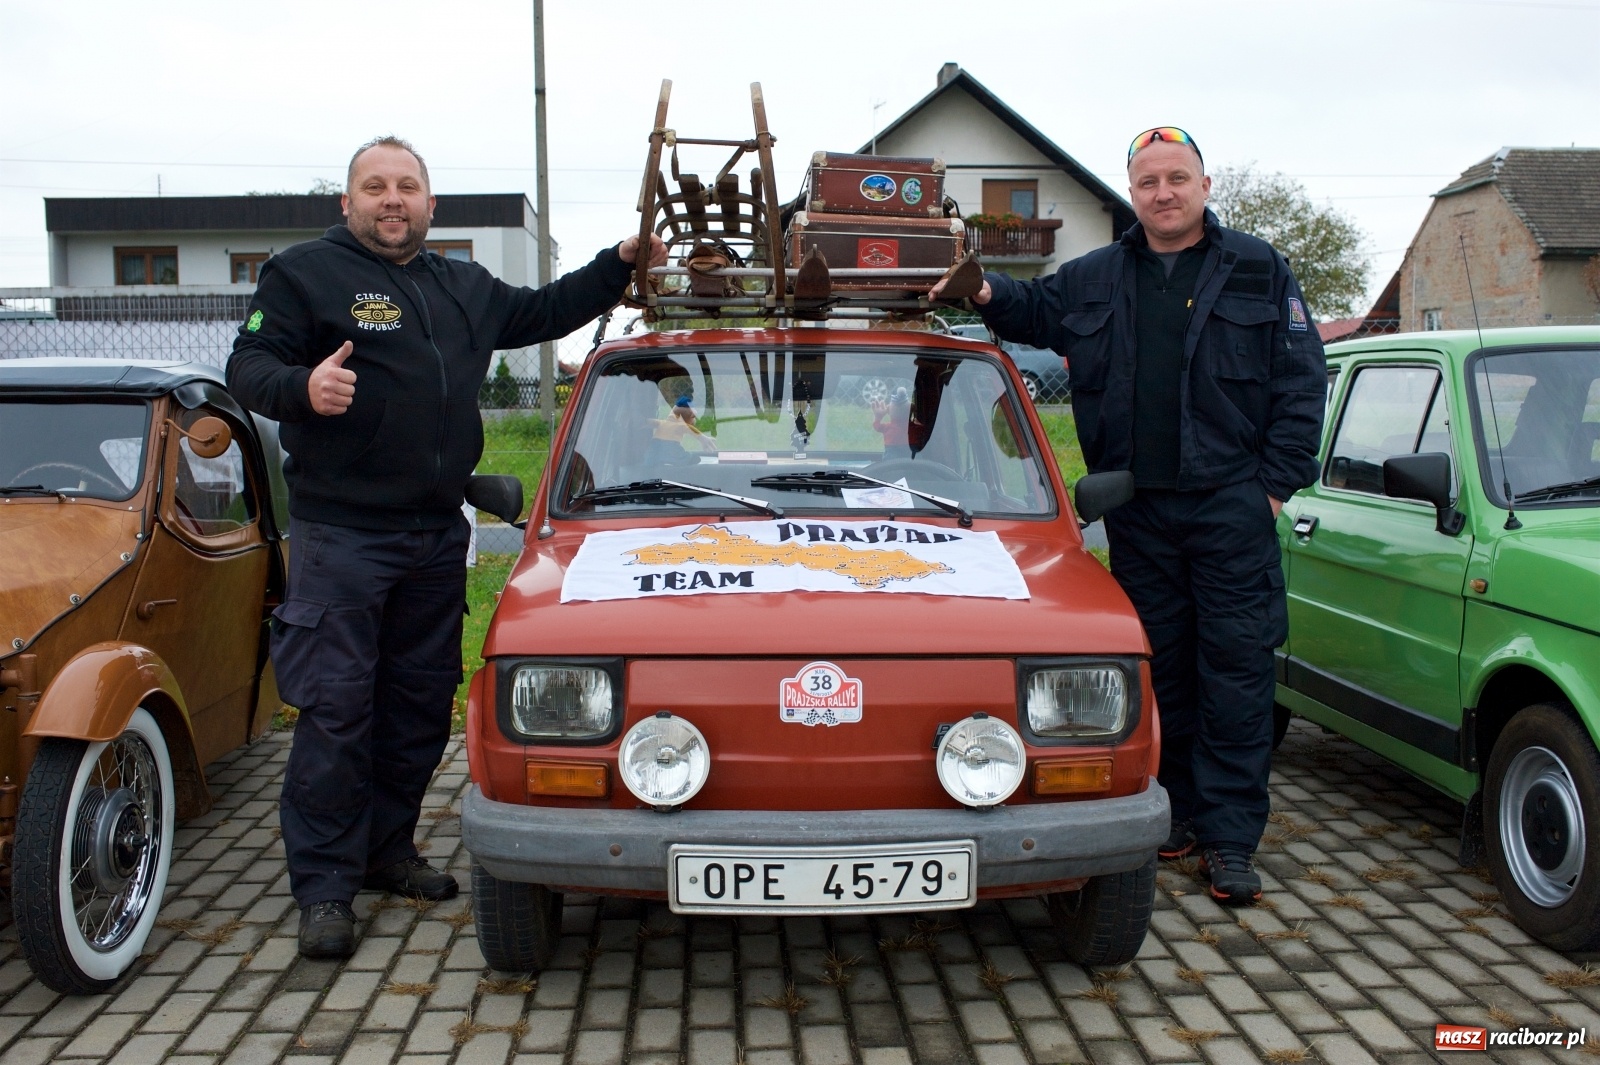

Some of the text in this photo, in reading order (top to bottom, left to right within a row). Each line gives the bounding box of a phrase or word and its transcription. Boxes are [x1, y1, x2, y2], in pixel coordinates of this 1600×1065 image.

[355, 293, 390, 301] CZECH
[358, 320, 401, 331] REPUBLIC
[633, 570, 755, 592] TEAM
[810, 674, 832, 691] 38
[827, 684, 856, 707] RALLYE
[703, 859, 943, 901] OPE 45-79
